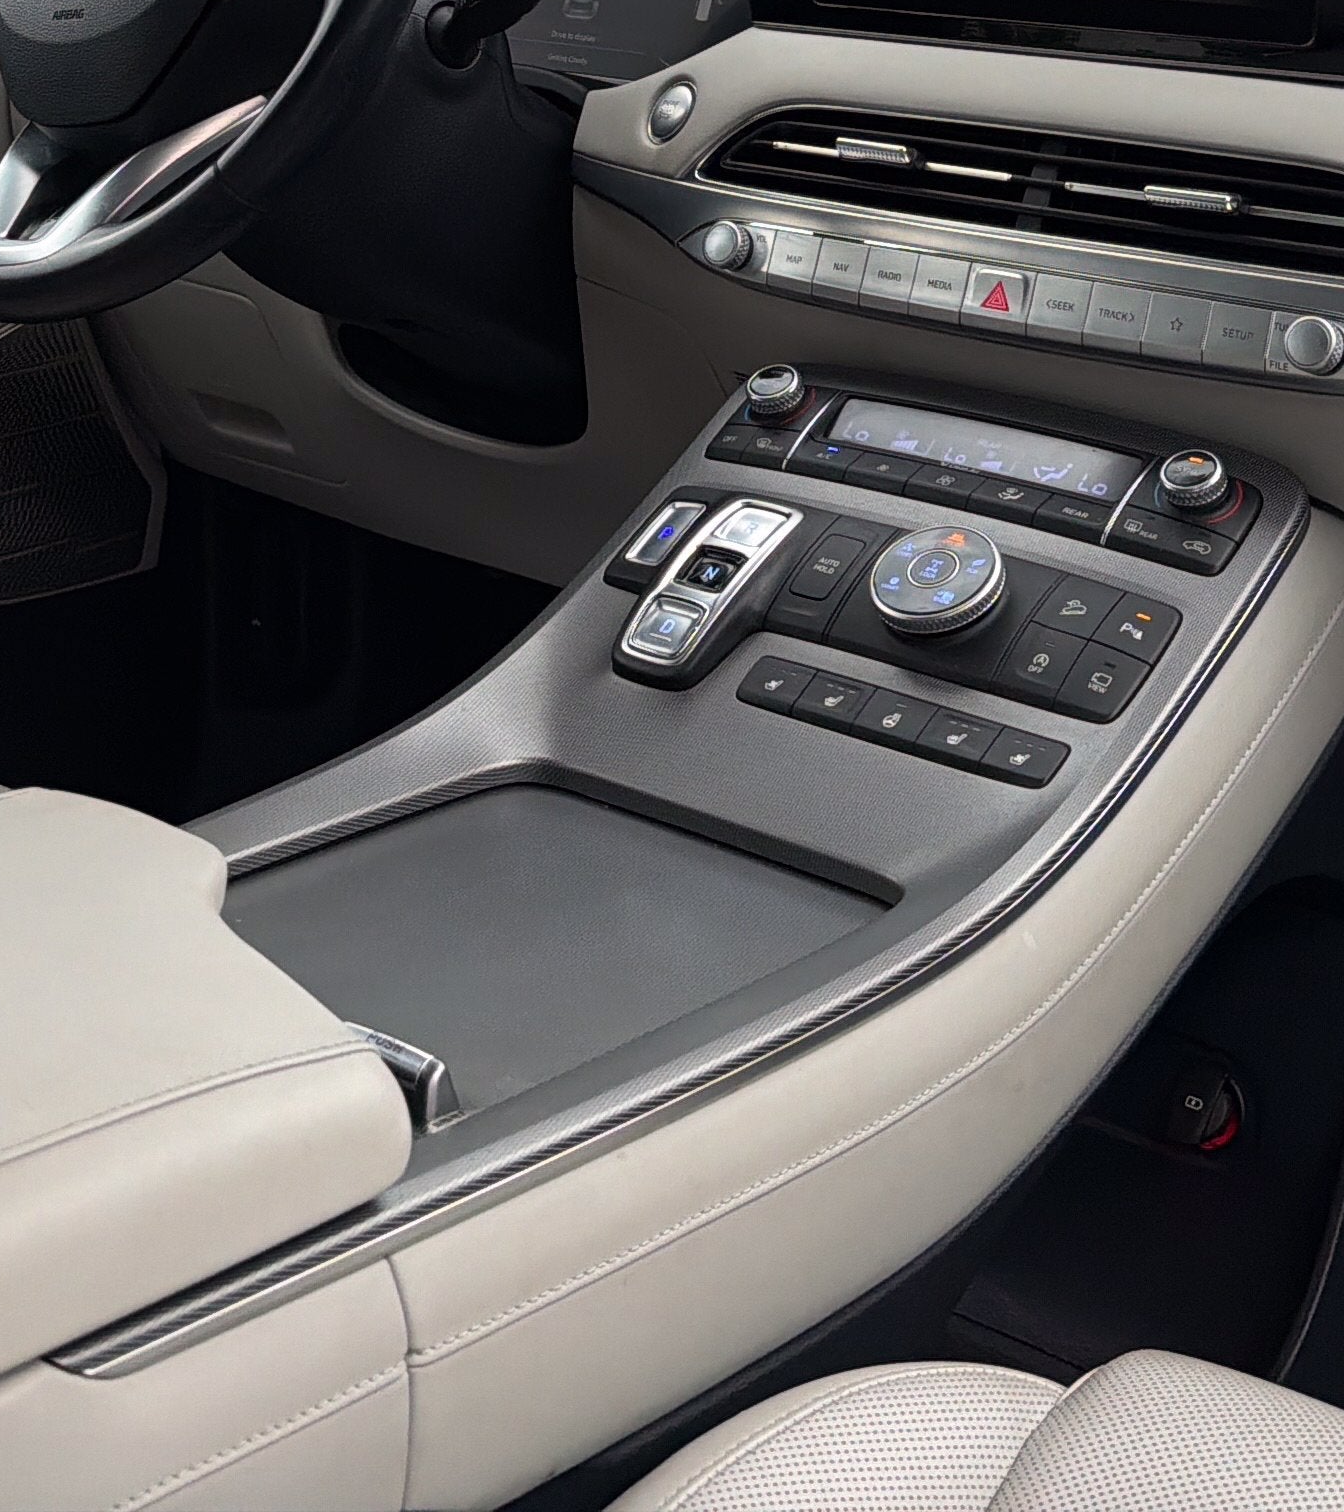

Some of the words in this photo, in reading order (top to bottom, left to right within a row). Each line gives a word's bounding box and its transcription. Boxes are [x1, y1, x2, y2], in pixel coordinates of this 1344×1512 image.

[52, 8, 85, 21] AIRBAG
[786, 254, 803, 265] MAP
[833, 261, 850, 273] NAV
[877, 269, 902, 282] RADIO
[926, 278, 953, 291] MEDIA
[1222, 326, 1255, 342] SETUP
[1269, 359, 1290, 372] FILE
[1062, 506, 1089, 519] REAR
[817, 556, 841, 567] AUTO
[703, 567, 720, 581] N
[812, 564, 836, 575] HOLD
[658, 618, 676, 634] D
[1027, 664, 1044, 674] OFF
